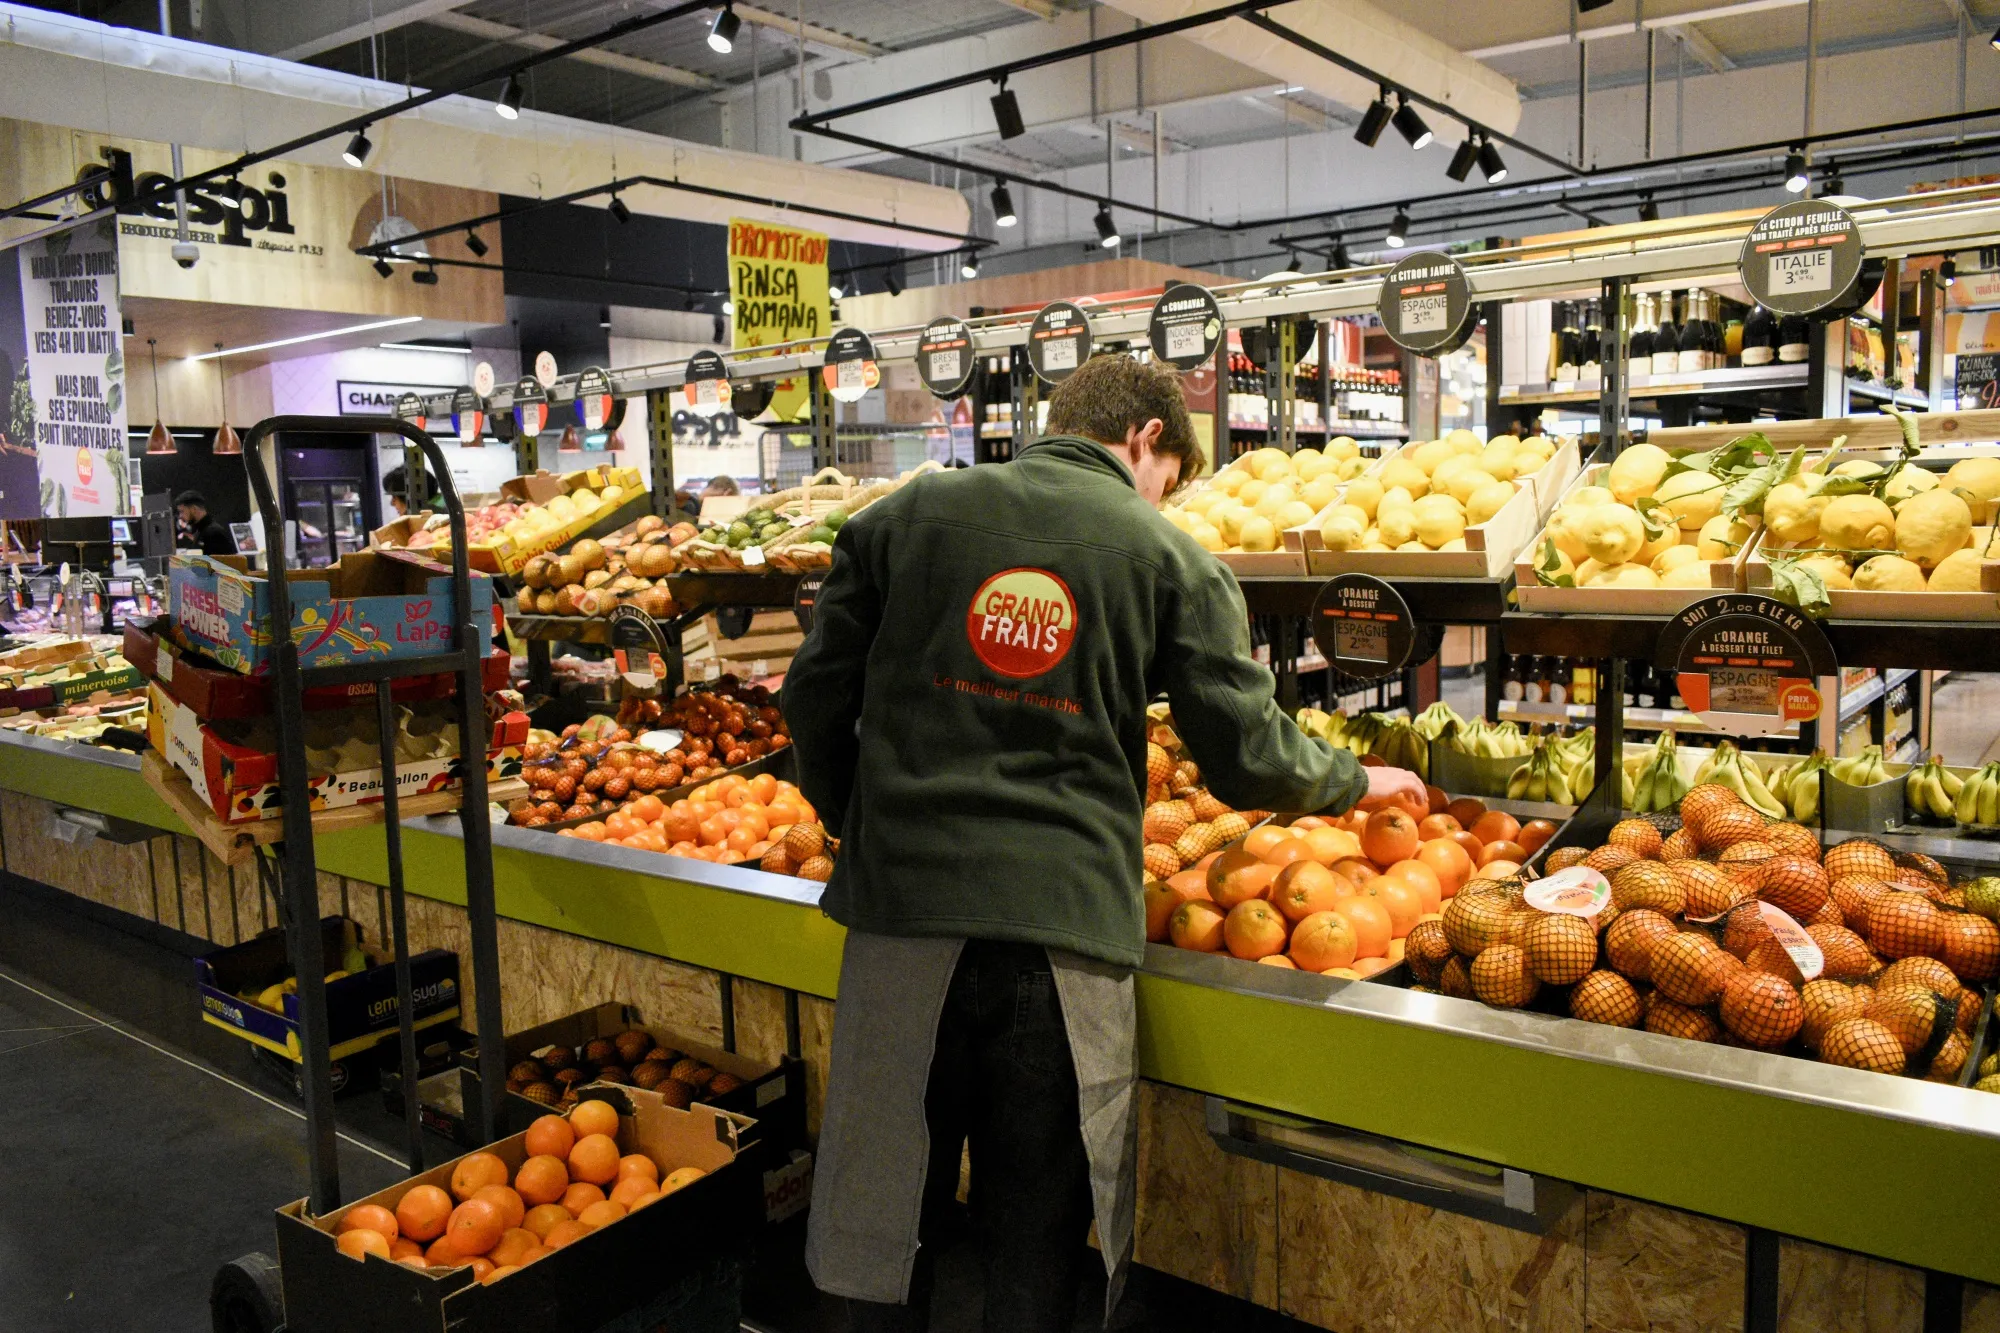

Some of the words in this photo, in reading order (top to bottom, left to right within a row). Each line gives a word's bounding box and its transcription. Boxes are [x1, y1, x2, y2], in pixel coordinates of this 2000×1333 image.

[76, 145, 295, 248] despi
[1752, 233, 1767, 242] NON
[1769, 227, 1793, 240] TRAITÉ
[1795, 224, 1819, 237] APRÈS
[1821, 221, 1852, 233] RÉCOLTE
[1761, 223, 1768, 231] LE
[1769, 215, 1804, 230] CITRON
[58, 253, 84, 278] NOUS
[85, 251, 116, 276] DONNE
[1398, 267, 1428, 281] CITRON
[1430, 263, 1455, 278] JAUNE
[1776, 252, 1826, 270] ITALIE
[49, 279, 98, 303] TOUJOURS
[1050, 309, 1073, 322] CITRON
[1402, 296, 1448, 312] ESPAGNE
[45, 304, 106, 328] RENDEZ-VOUS
[736, 298, 818, 338] ROMANA
[930, 325, 949, 336] CITRON
[1167, 323, 1205, 338] INDONESIE
[35, 331, 58, 354] VERS
[59, 331, 72, 354] 4H
[73, 331, 86, 354] DU
[933, 352, 959, 364] BRESIL
[56, 375, 79, 398] MAIS
[49, 398, 66, 421] SES
[38, 422, 60, 446] SONT
[182, 581, 226, 618] FRESH
[985, 590, 1064, 627] GRAND
[1349, 599, 1376, 609] DESSERT
[181, 601, 231, 647] POWER
[1682, 605, 1709, 628] SOIT
[1758, 602, 1767, 613] €
[1769, 604, 1785, 620] LE
[1785, 613, 1804, 631] KG
[396, 620, 453, 643] LaPa
[980, 614, 1060, 654] FRAIS
[1338, 622, 1388, 638] ESPAGNE
[1714, 630, 1769, 645] L'ORANGE
[1710, 642, 1745, 654] DESSERT
[1748, 645, 1759, 655] EN
[1761, 645, 1784, 655] FILET
[64, 673, 129, 697] minervoise
[933, 672, 952, 688] Le
[955, 678, 1020, 701] meilleur
[1711, 671, 1779, 688] ESPAGNE
[1787, 695, 1809, 703] PRIX
[349, 771, 429, 793] Beauallon
[367, 982, 438, 1018] Lemsud
